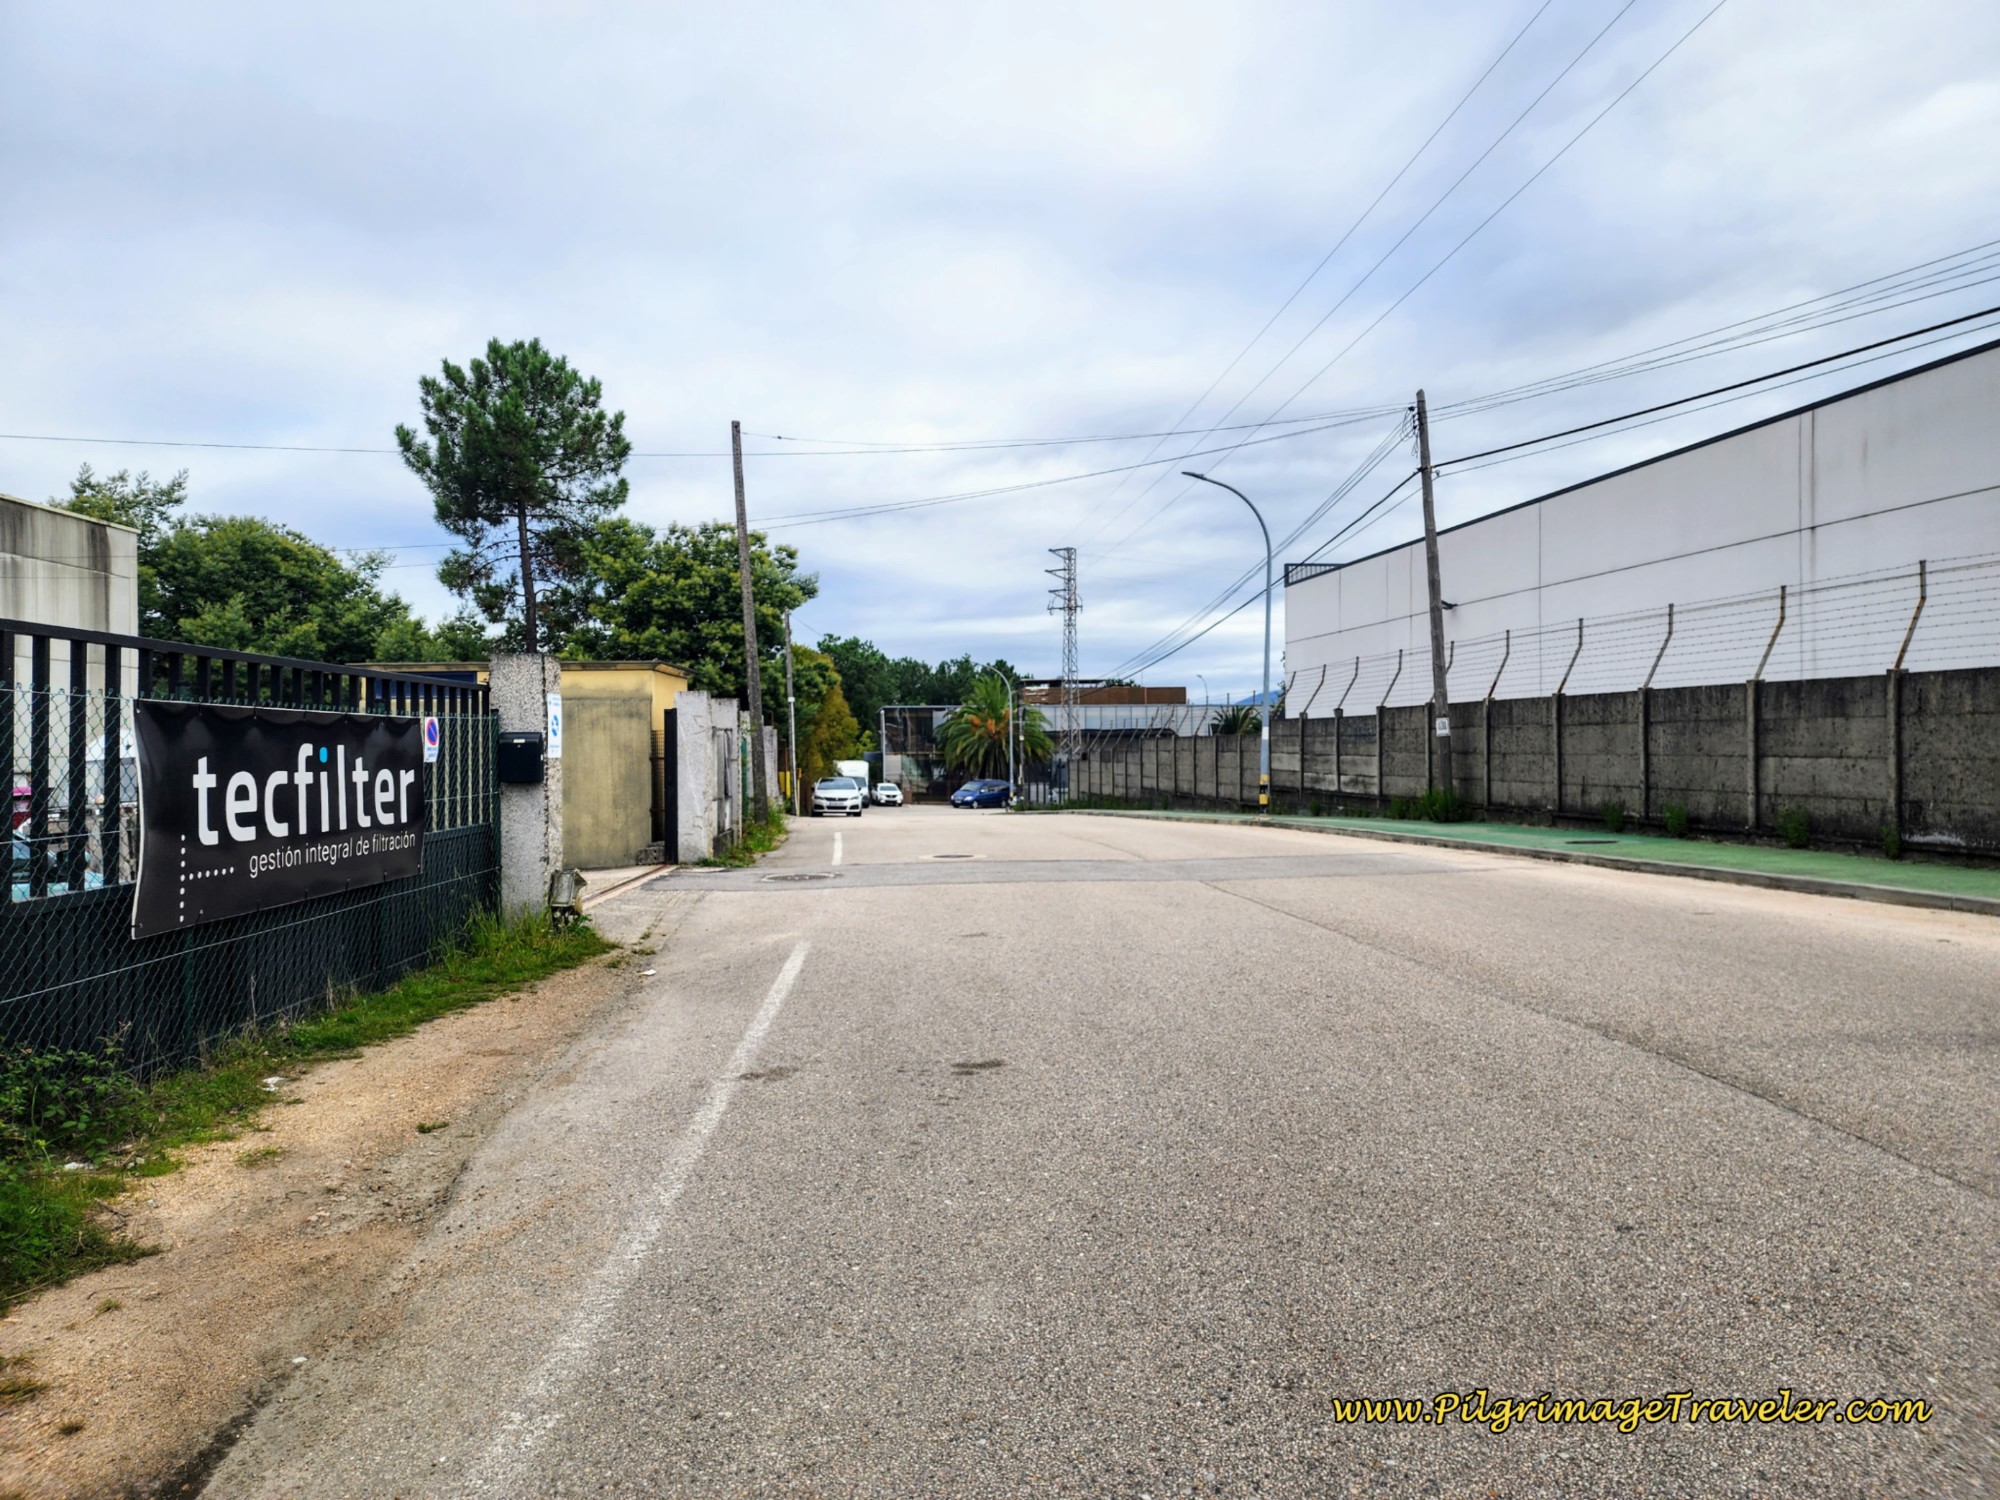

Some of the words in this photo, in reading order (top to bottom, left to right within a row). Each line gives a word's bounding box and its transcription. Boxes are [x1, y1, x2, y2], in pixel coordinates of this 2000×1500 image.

[192, 743, 415, 846] tecfilter
[249, 845, 302, 878] gestión
[305, 837, 353, 865] integral
[356, 836, 370, 856] de
[372, 830, 416, 854] filtración
